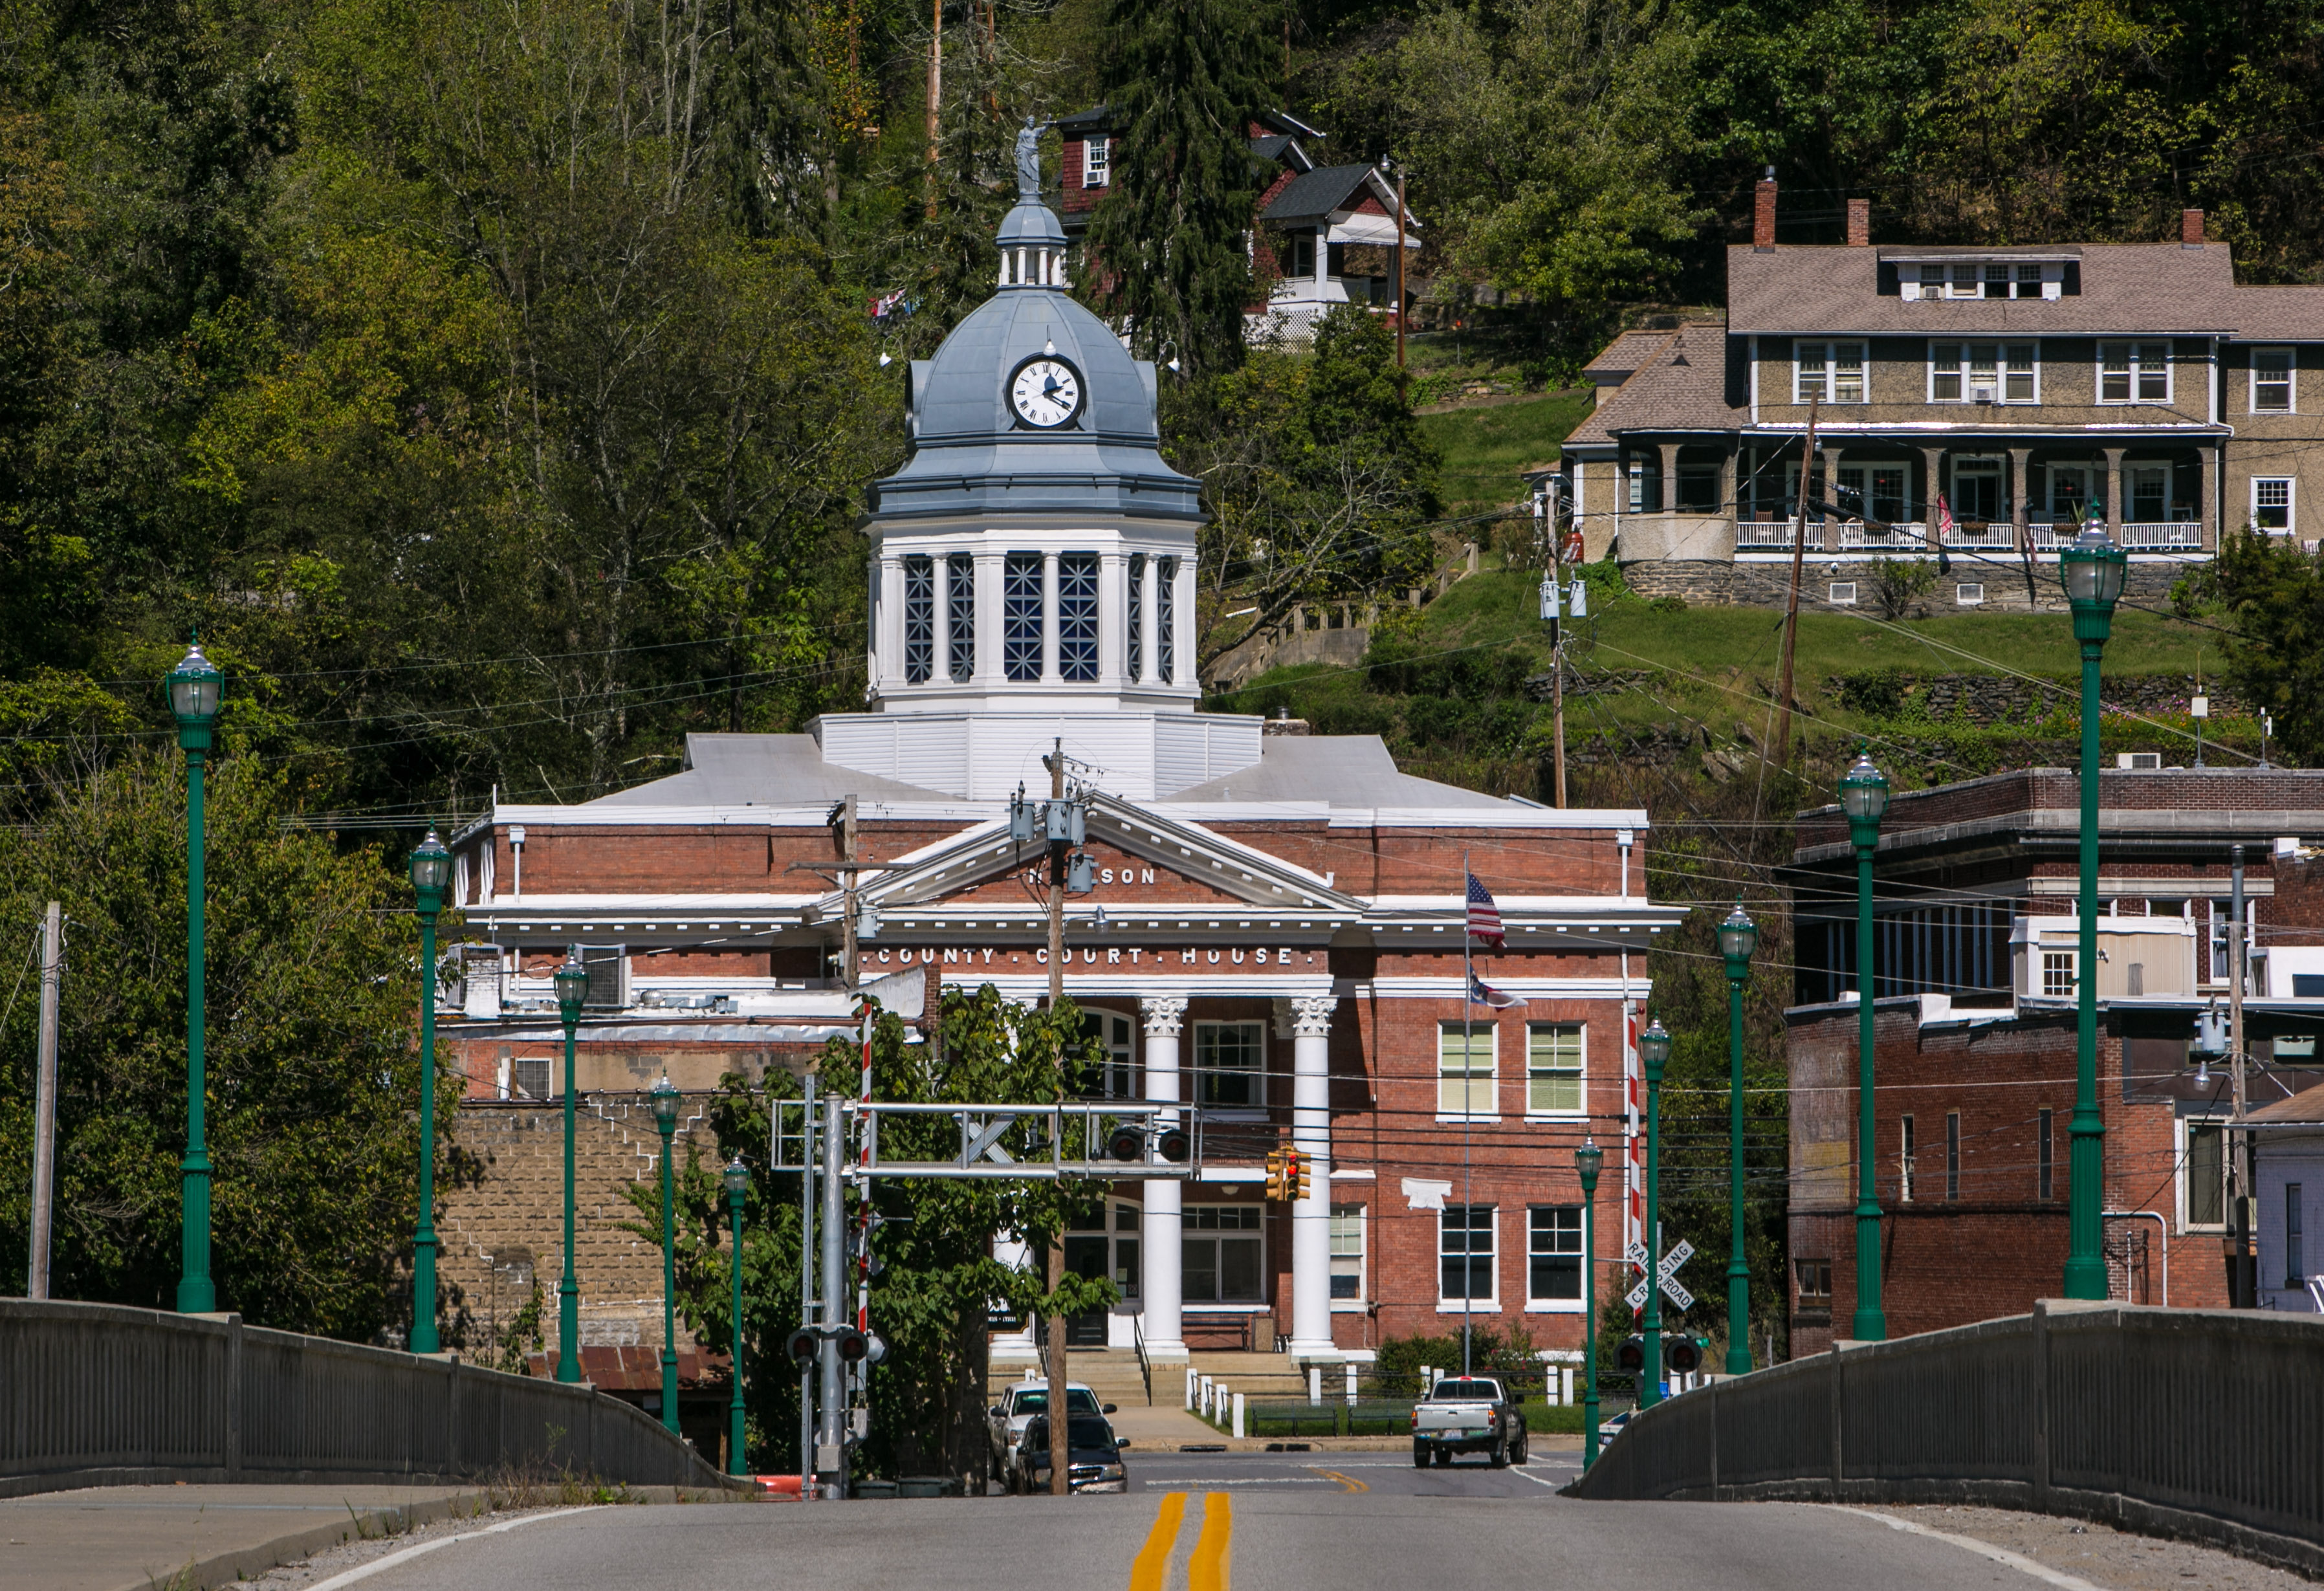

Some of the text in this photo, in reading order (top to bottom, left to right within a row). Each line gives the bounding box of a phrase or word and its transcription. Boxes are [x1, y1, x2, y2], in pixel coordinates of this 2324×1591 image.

[1029, 868, 1154, 884] MSON
[878, 948, 1291, 964] COUNTY COURT HOUSE
[1632, 1245, 1688, 1303] CRSSING
